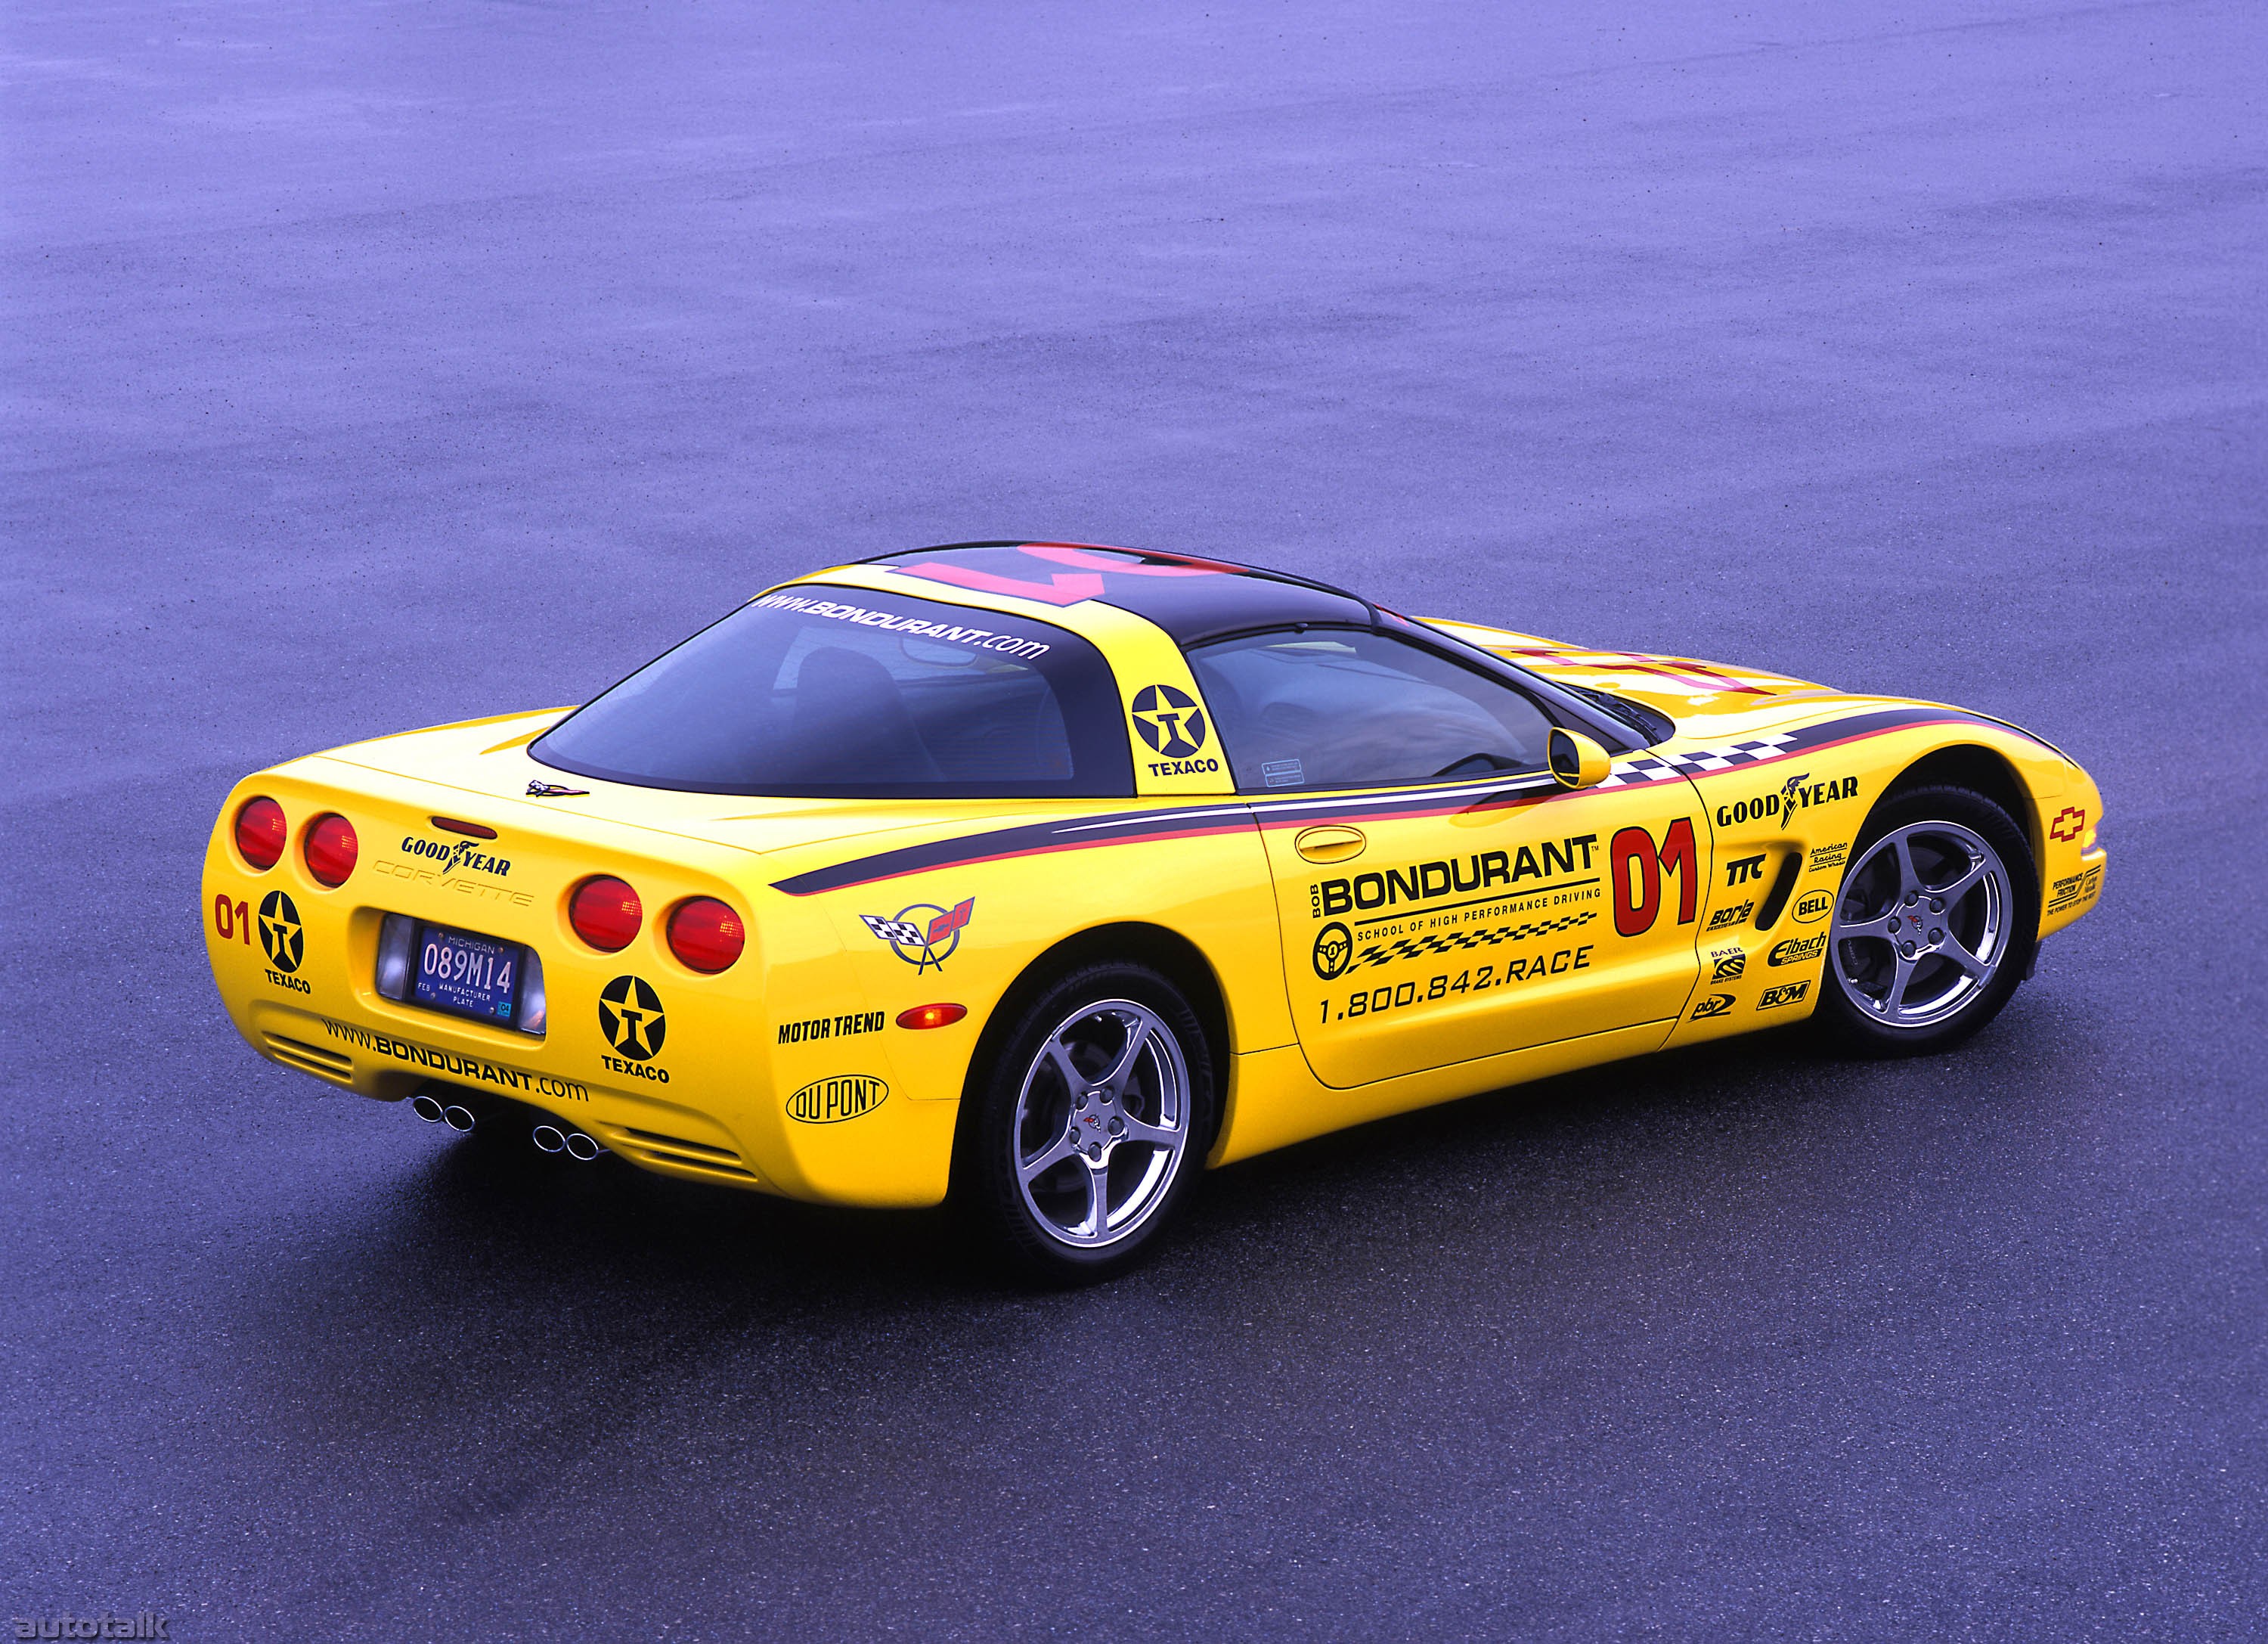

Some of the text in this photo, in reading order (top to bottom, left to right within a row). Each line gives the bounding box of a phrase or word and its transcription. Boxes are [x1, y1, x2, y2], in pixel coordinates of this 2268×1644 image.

[1148, 758, 1219, 777] TEXACO
[1810, 842, 1848, 855] American
[1814, 853, 1842, 864] Racing
[1310, 884, 1321, 919] BOB
[1321, 833, 1597, 917] BONDURANT
[1610, 816, 1698, 938] 01
[1727, 853, 1767, 887] TTC
[373, 860, 534, 907] CORVETTE
[1357, 888, 1600, 941] SCHOOL OF HIGH PERFORMANCE DRIVING
[1799, 896, 1828, 916] BELL
[215, 894, 250, 945] 01
[448, 936, 495, 954] MICHIGAN
[1710, 948, 1743, 958] BAER
[1768, 931, 1826, 967] Eibach
[1780, 949, 1818, 965] SPRINGS
[424, 943, 511, 994] 089M14
[265, 969, 311, 994] TEXACO
[418, 982, 430, 991] FEB
[438, 983, 491, 1001] MANUFACTURER
[1320, 945, 1594, 1024] 1.800.842.RACE
[454, 996, 474, 1007] PLATE
[1759, 982, 1808, 1007] B&M
[778, 1011, 885, 1044] MOTOR TREND
[601, 1055, 670, 1084] TEXACO
